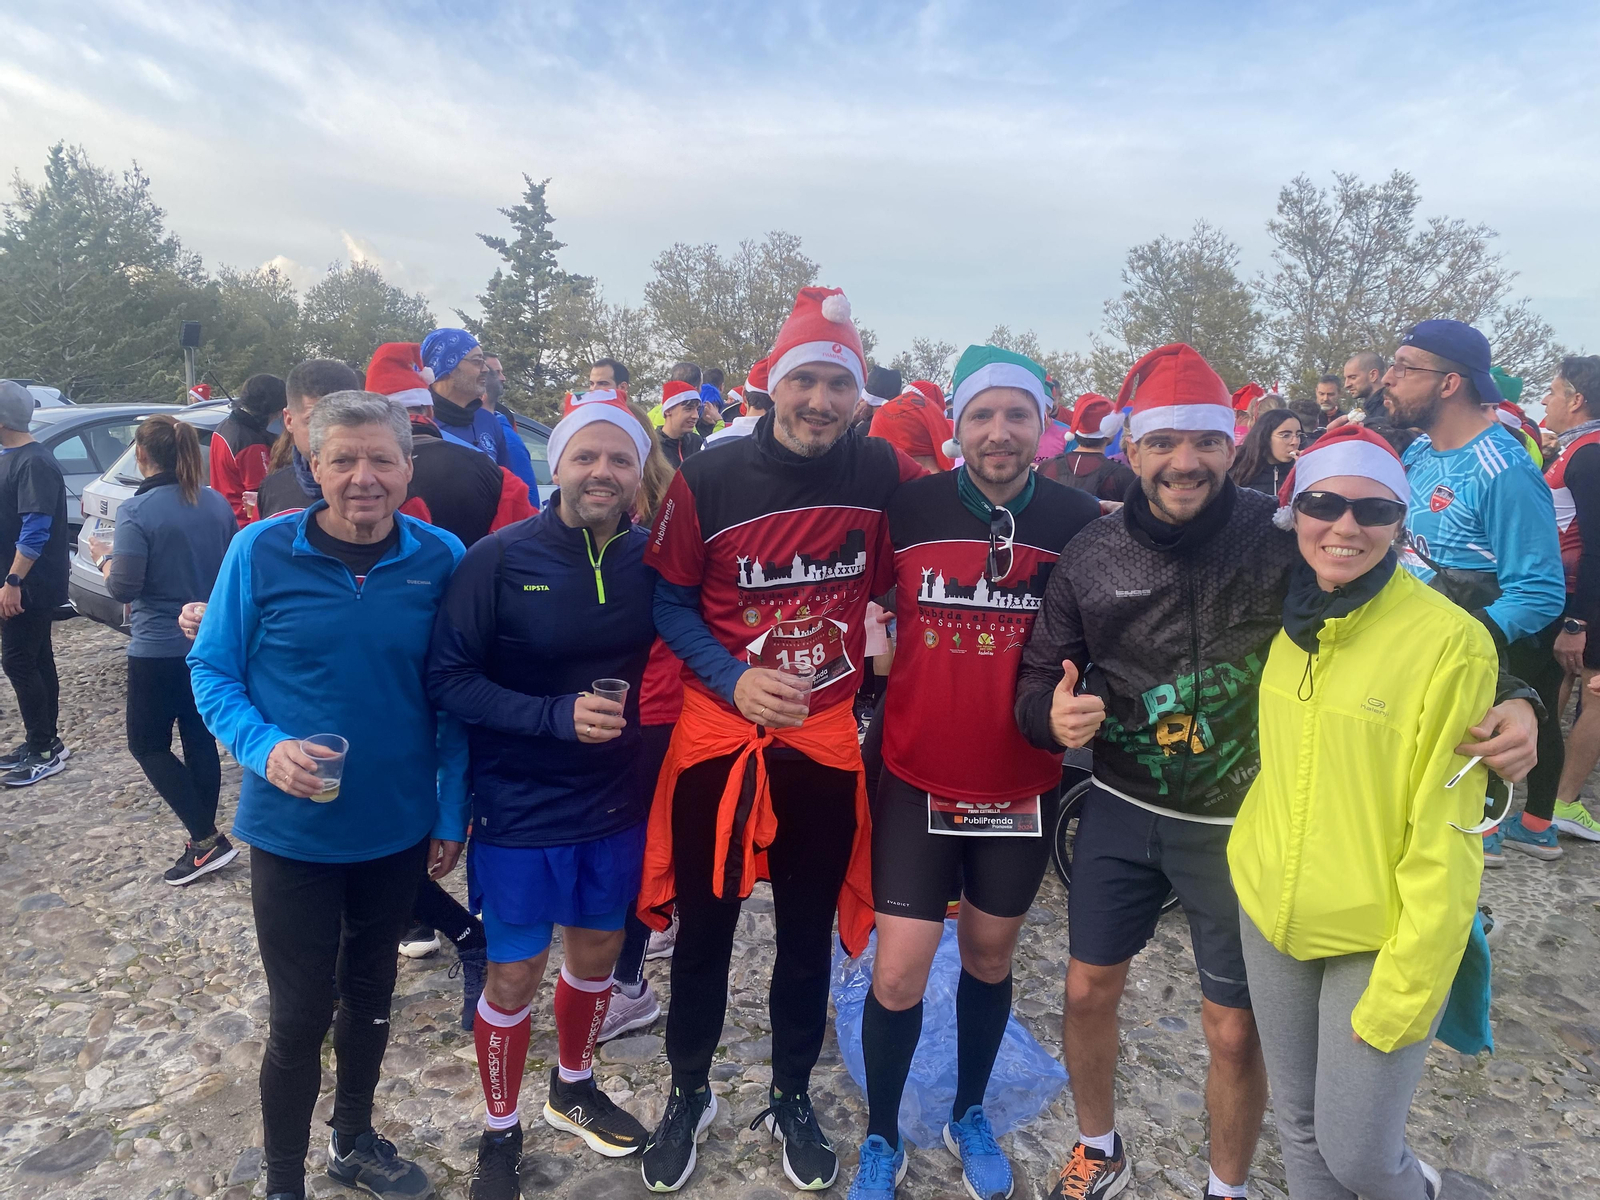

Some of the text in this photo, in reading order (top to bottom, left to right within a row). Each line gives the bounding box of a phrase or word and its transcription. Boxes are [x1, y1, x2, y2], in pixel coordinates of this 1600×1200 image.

[655, 498, 673, 546] PubliPrenda
[918, 606, 962, 620] Subida
[972, 614, 987, 622] al
[919, 615, 931, 625] de
[937, 618, 981, 630] Santa
[775, 643, 826, 670] 158
[963, 816, 1013, 825] PubliPrenda
